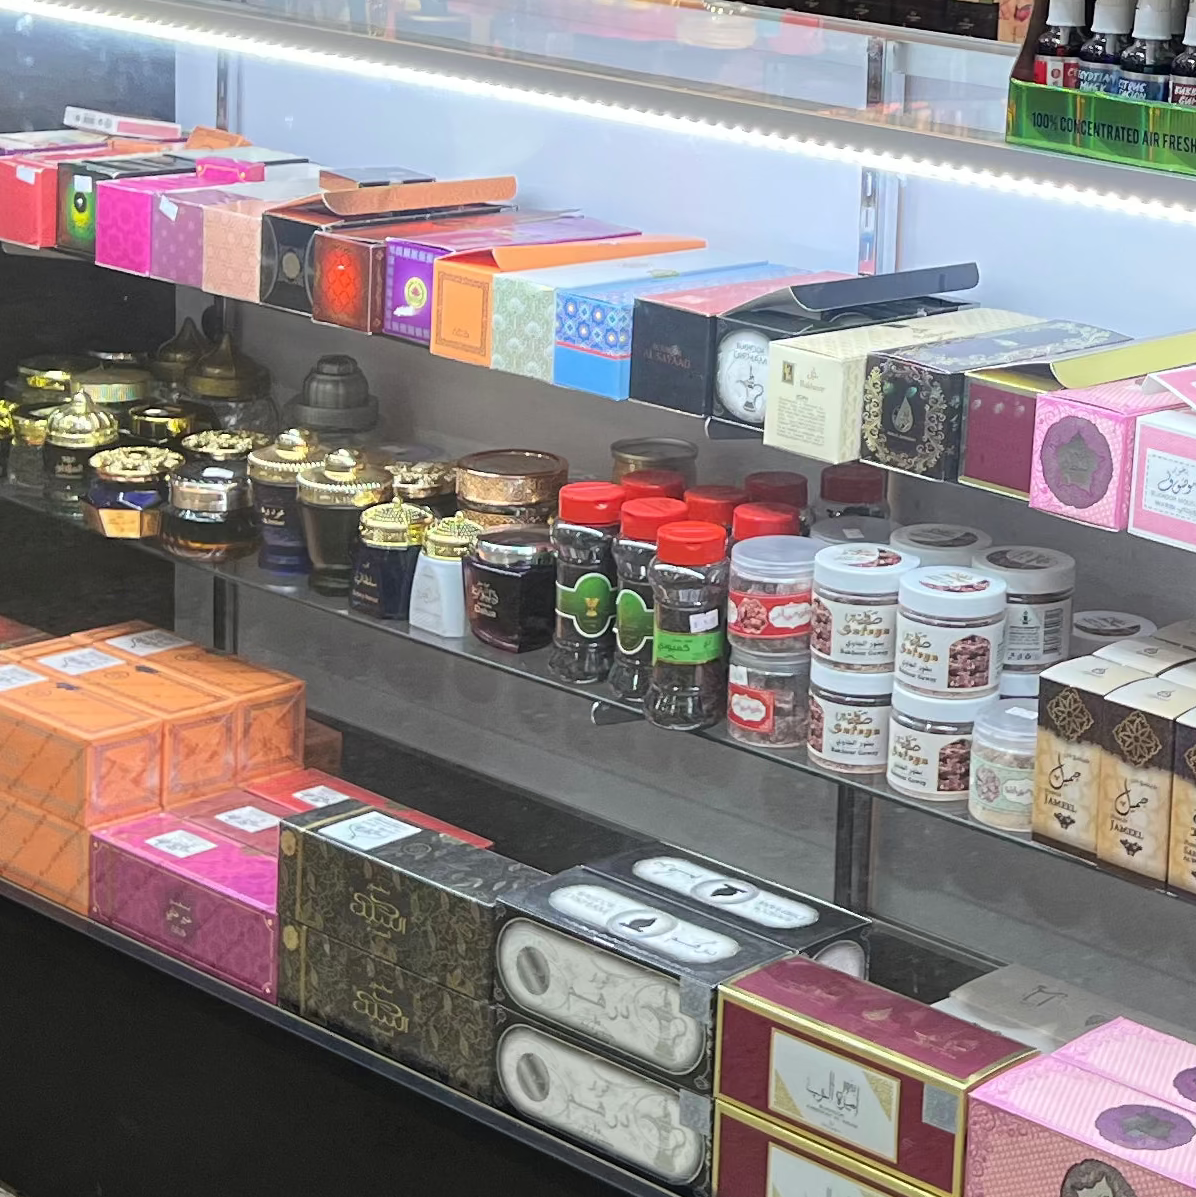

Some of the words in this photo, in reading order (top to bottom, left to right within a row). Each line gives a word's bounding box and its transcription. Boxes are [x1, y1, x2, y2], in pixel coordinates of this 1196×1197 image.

[1032, 112, 1058, 130] 100%
[1060, 117, 1139, 146] CONCENTRATED
[1142, 130, 1160, 146] AIR
[1044, 792, 1078, 813] JAMEEL
[1110, 819, 1146, 840] JAMEEL
